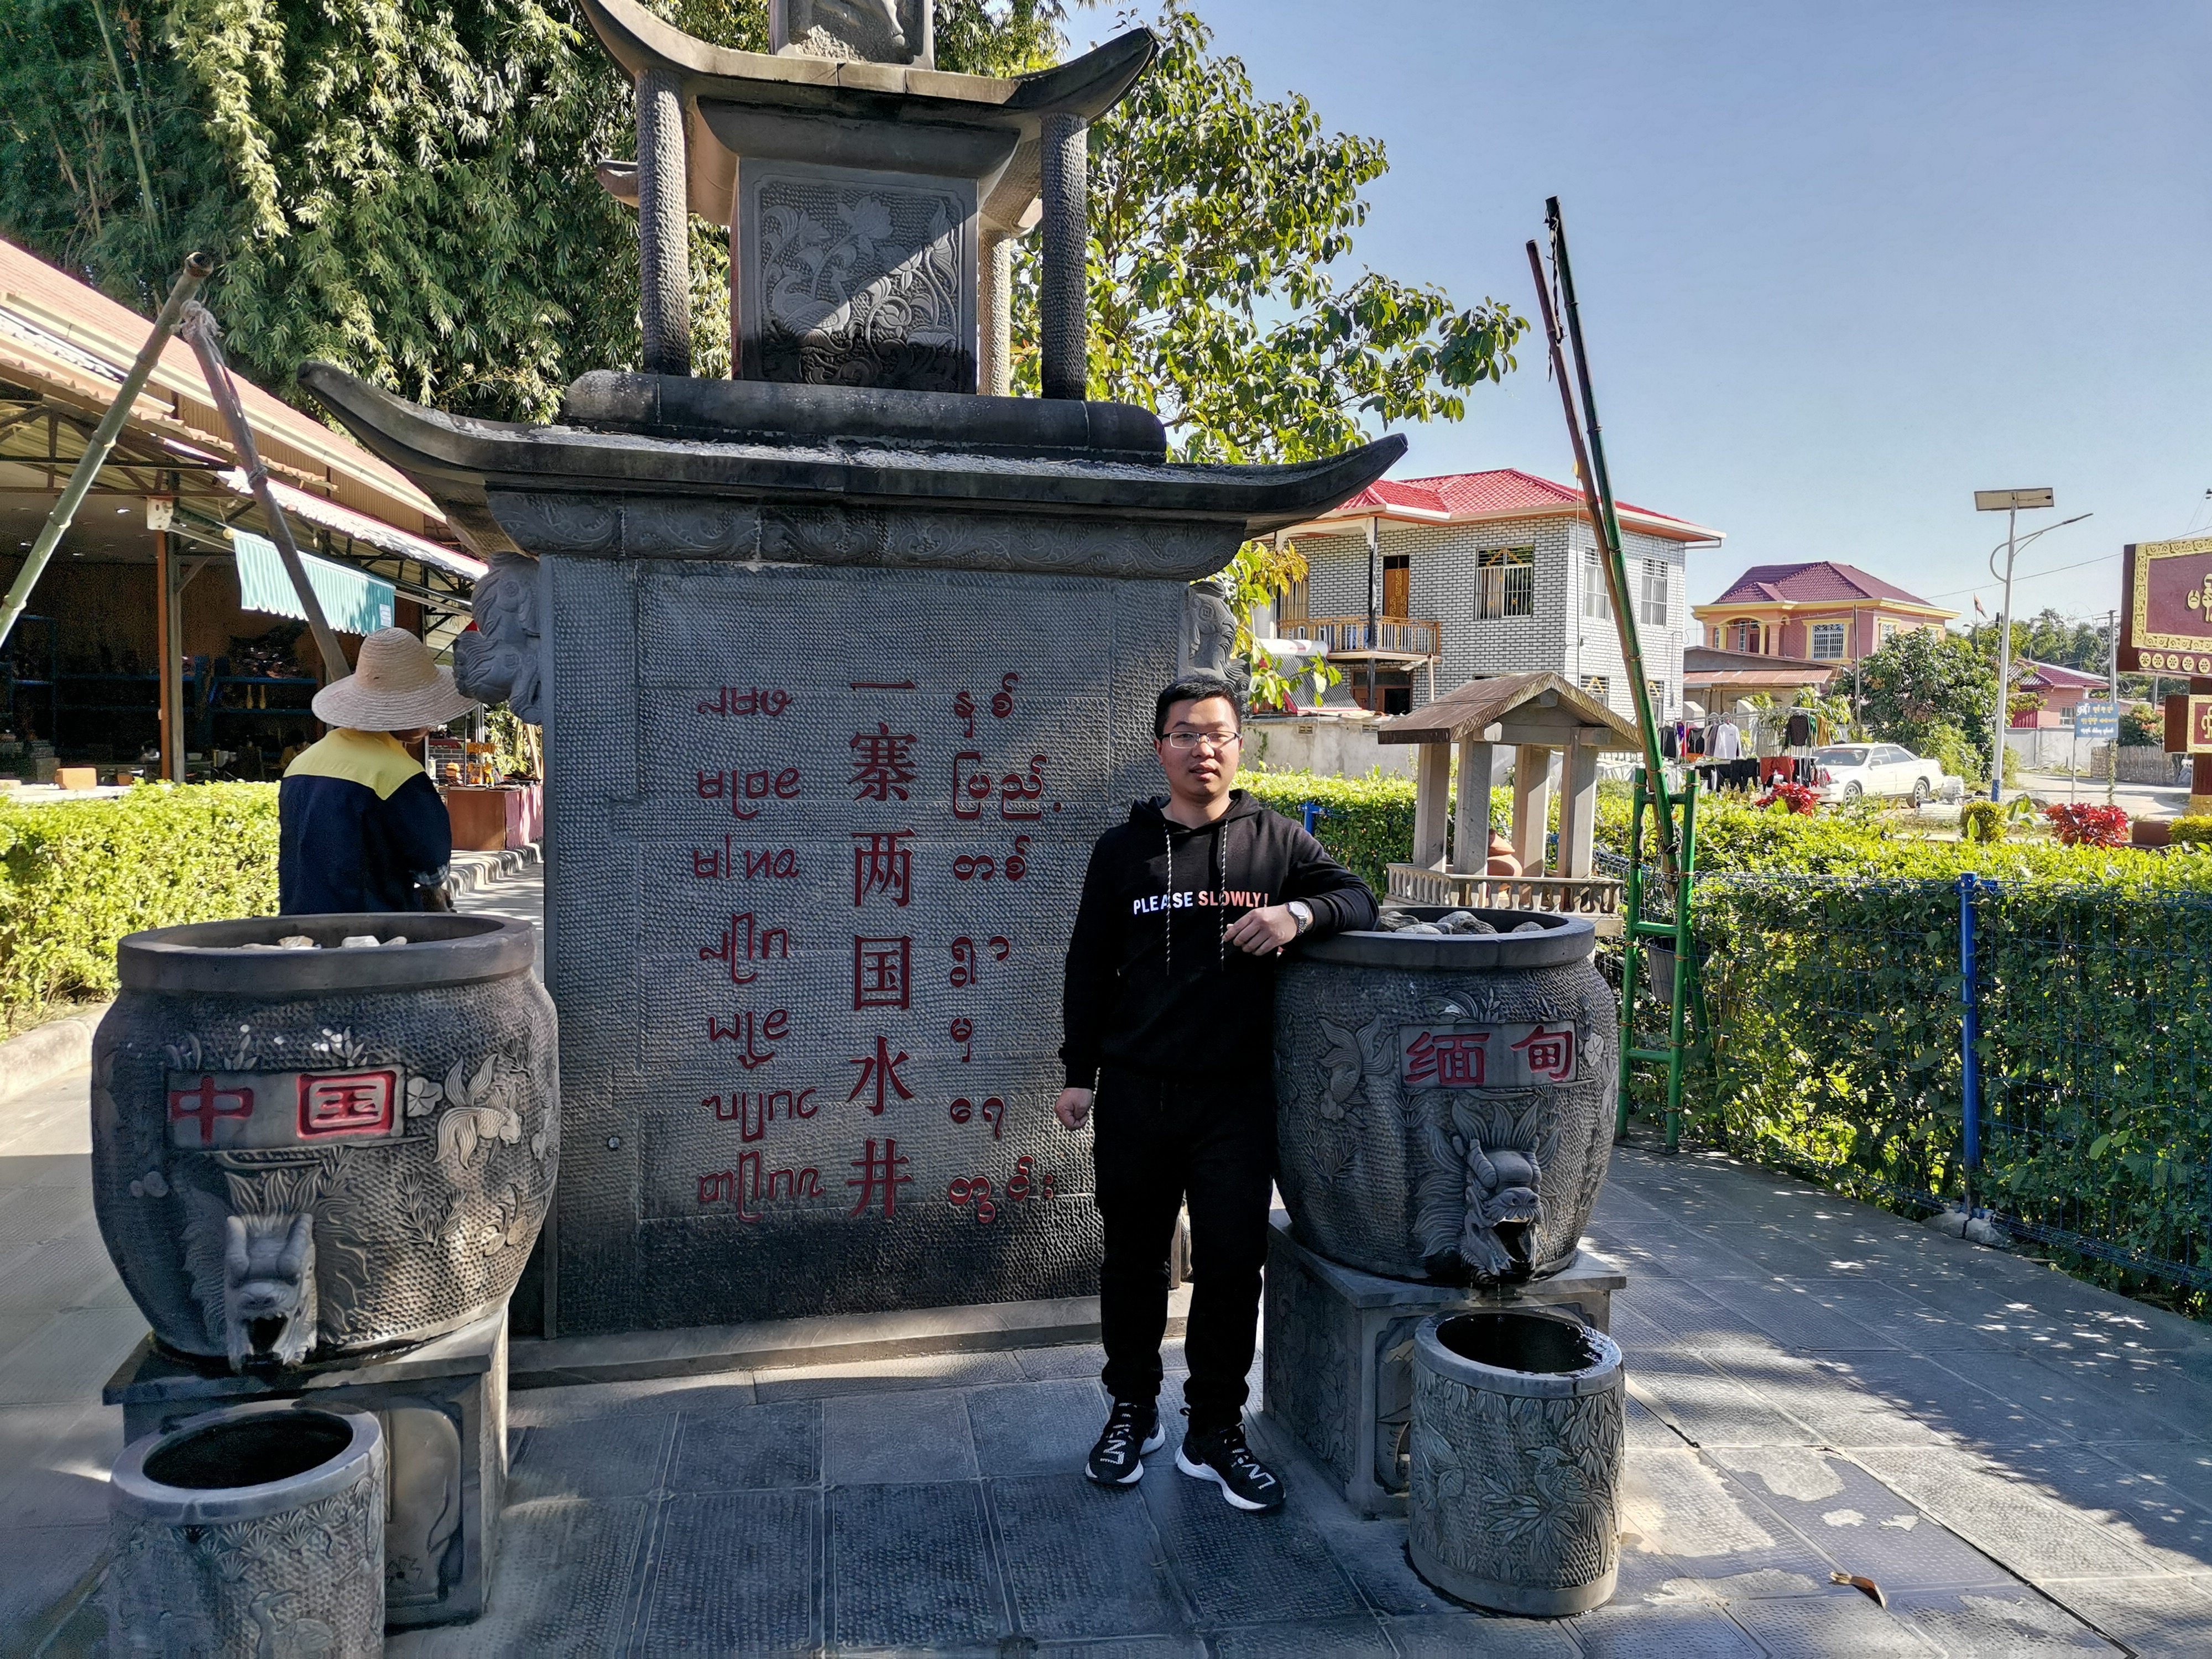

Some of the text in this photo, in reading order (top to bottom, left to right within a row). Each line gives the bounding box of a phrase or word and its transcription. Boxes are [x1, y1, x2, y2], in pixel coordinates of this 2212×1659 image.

[1133, 890, 1269, 915] PLEASE SLOWLY!
[847, 679, 918, 1218] 一寨两国水井
[1405, 1025, 1573, 1085] 缅甸
[169, 1071, 397, 1145] 中国
